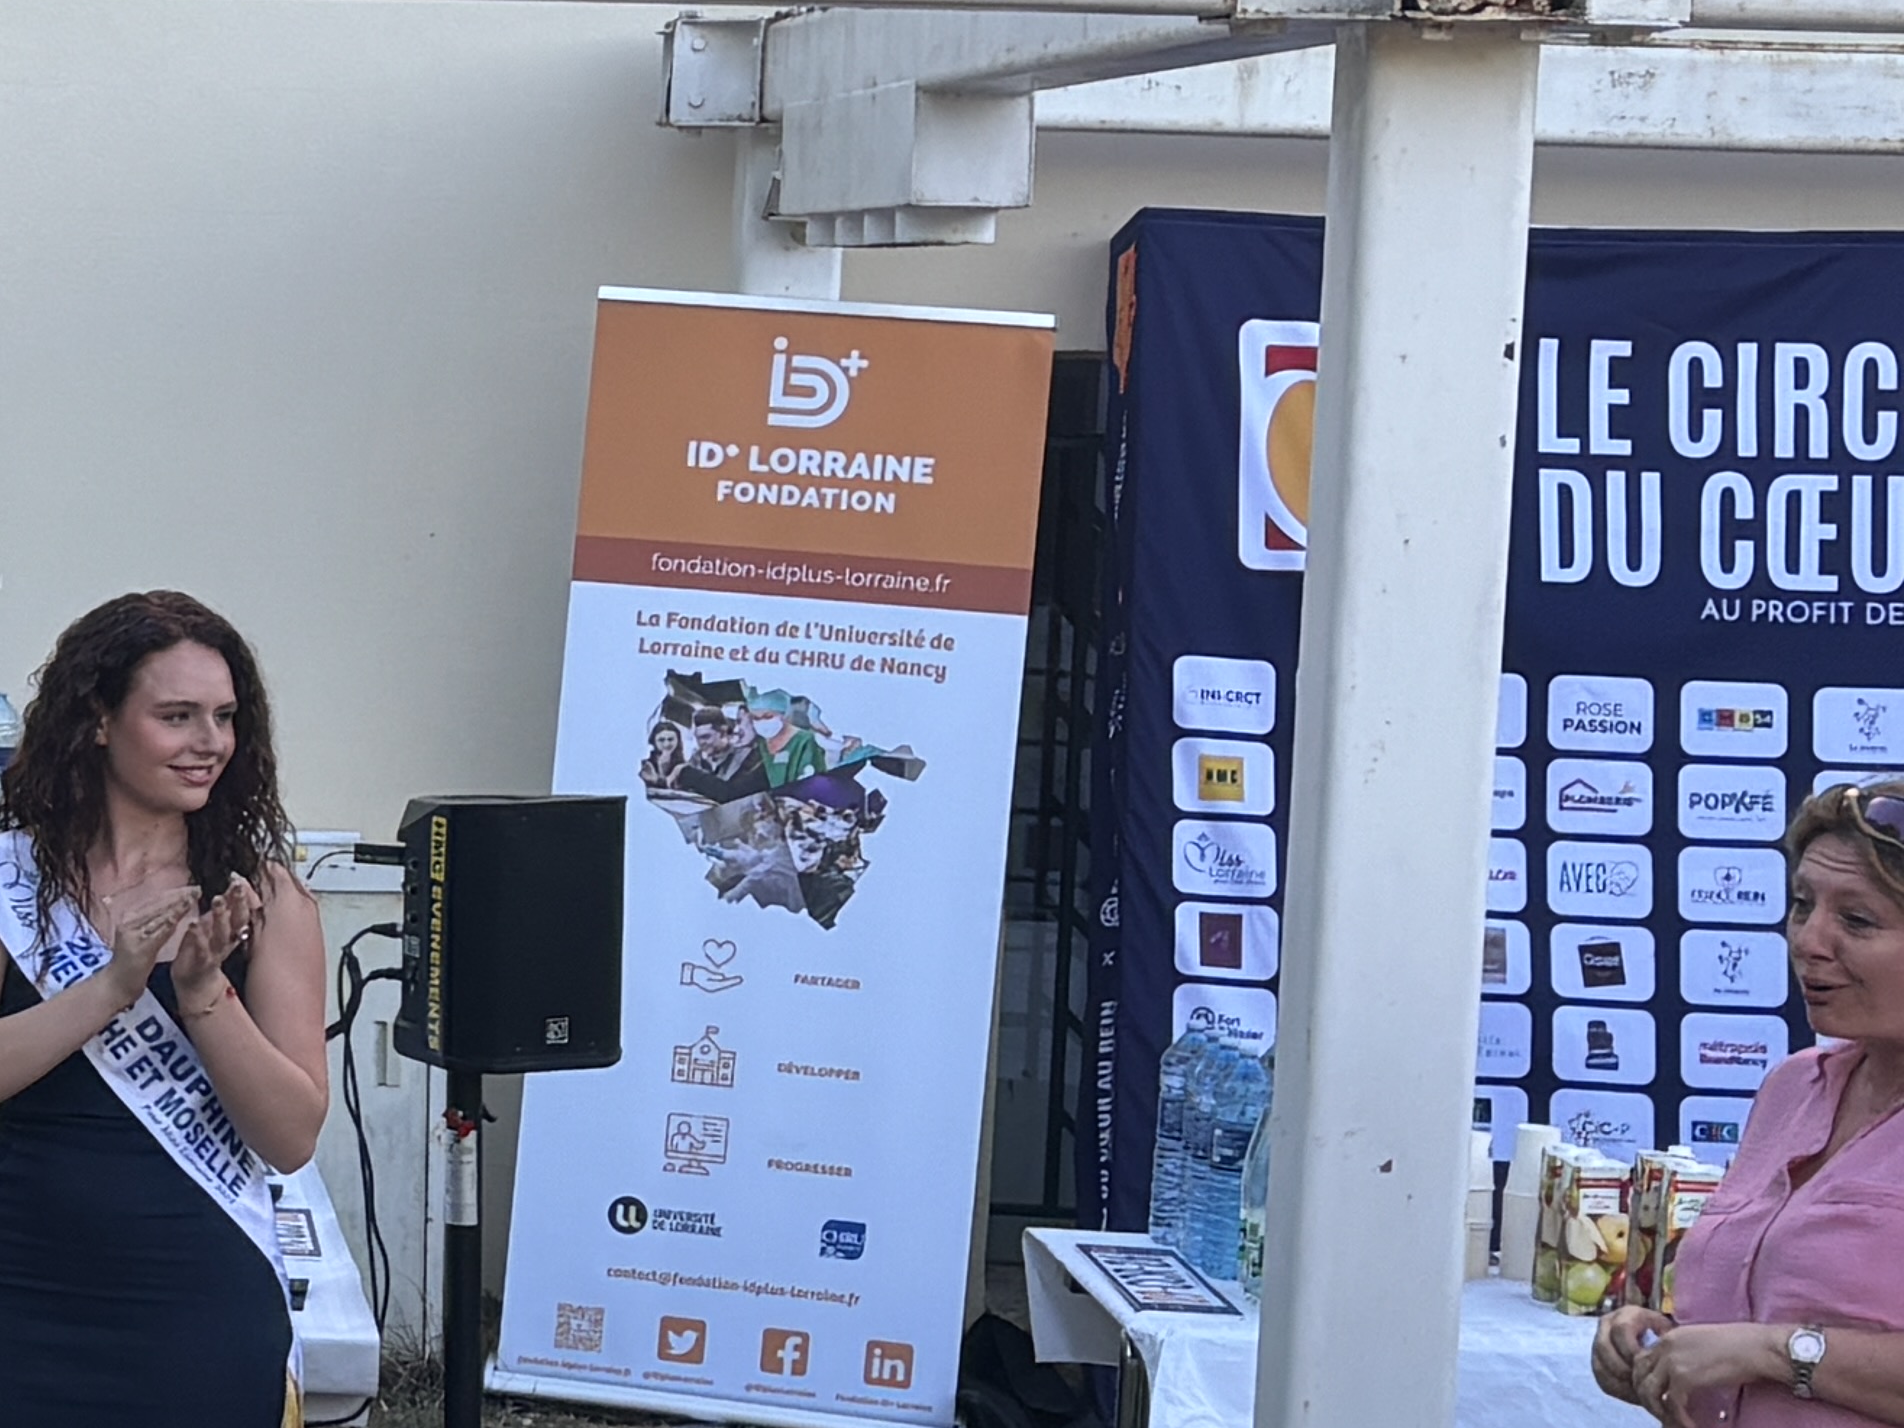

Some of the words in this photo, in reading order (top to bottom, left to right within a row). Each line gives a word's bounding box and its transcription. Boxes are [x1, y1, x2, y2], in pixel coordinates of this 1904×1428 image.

[1538, 338, 1632, 455] LE
[1668, 340, 1898, 461] CIRC
[748, 445, 936, 484] LORRAINE
[717, 480, 896, 514] FONDATION
[1539, 468, 1661, 587] DU
[651, 552, 952, 593] fondation-idplus-lorraine.fr
[636, 610, 661, 628] La
[666, 612, 769, 637] Fondation
[775, 620, 800, 639] de
[929, 634, 955, 651] de
[1700, 598, 1740, 621] AU
[1752, 601, 1854, 624] PROFIT
[638, 637, 724, 660] Lorraine
[729, 645, 749, 662] et
[754, 647, 780, 666] du
[785, 650, 846, 669] CHRU
[850, 653, 876, 673] de
[880, 657, 947, 684] Nancy
[1563, 718, 1641, 735] PASSION
[1576, 702, 1623, 717] ROSE
[136, 1015, 256, 1178] DAUPHINE
[125, 1055, 164, 1090] ET
[154, 1087, 246, 1197] MOSELLE
